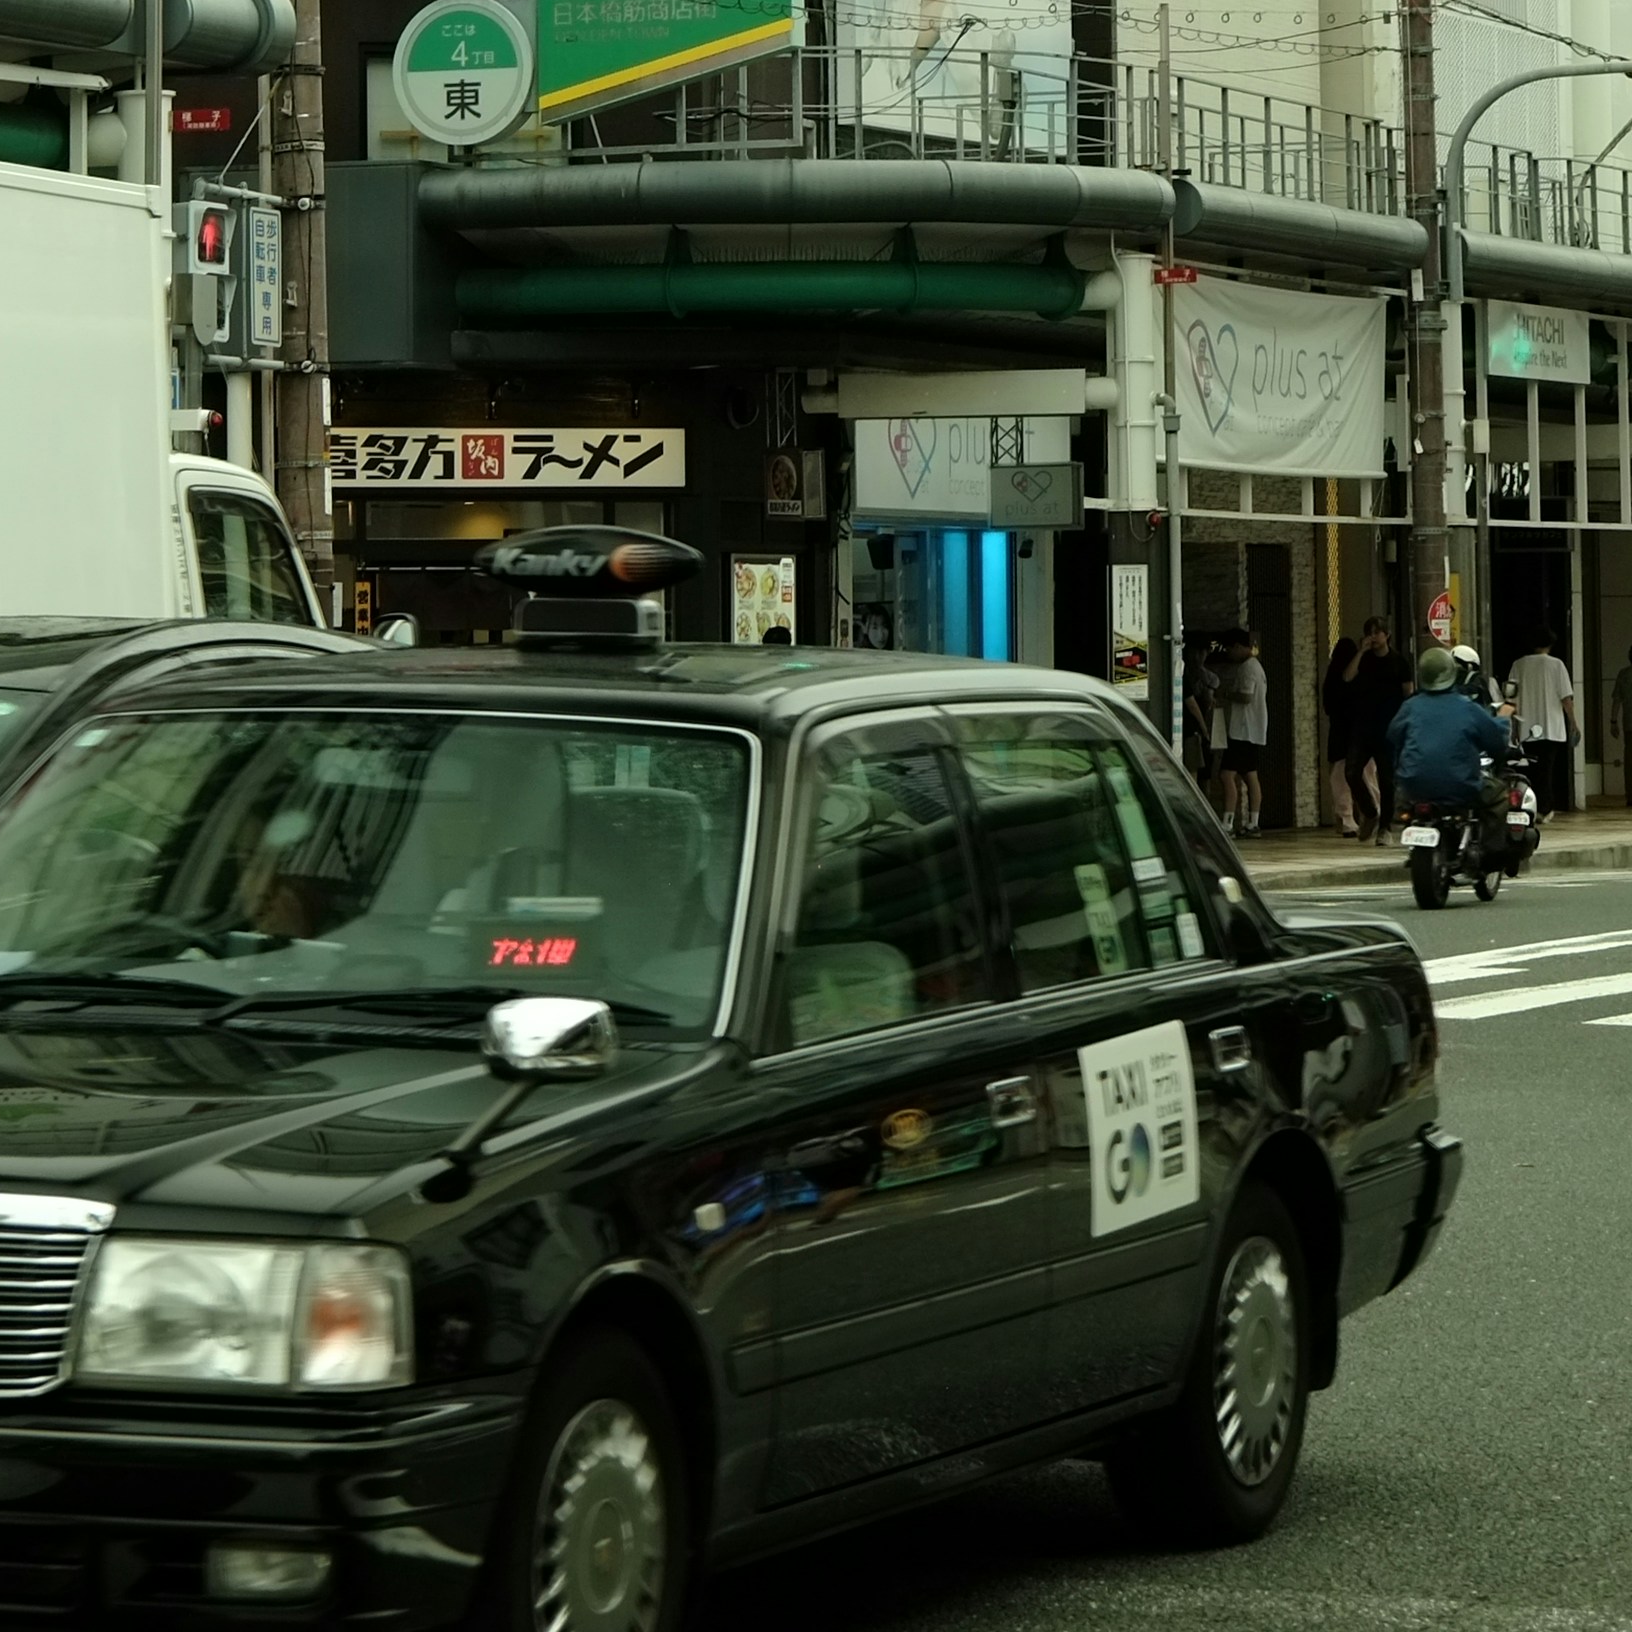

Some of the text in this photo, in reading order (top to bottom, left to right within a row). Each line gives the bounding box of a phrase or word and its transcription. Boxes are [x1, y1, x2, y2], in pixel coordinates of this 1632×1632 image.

[441, 24, 477, 38] ここは
[450, 40, 496, 68] 4丁目
[443, 79, 483, 122] 東
[255, 219, 266, 285] 自転車
[266, 219, 277, 285] 歩行者
[261, 290, 272, 336] 専用
[1252, 326, 1344, 413] plus at
[512, 434, 664, 480] ラーメン
[948, 419, 988, 478] plu
